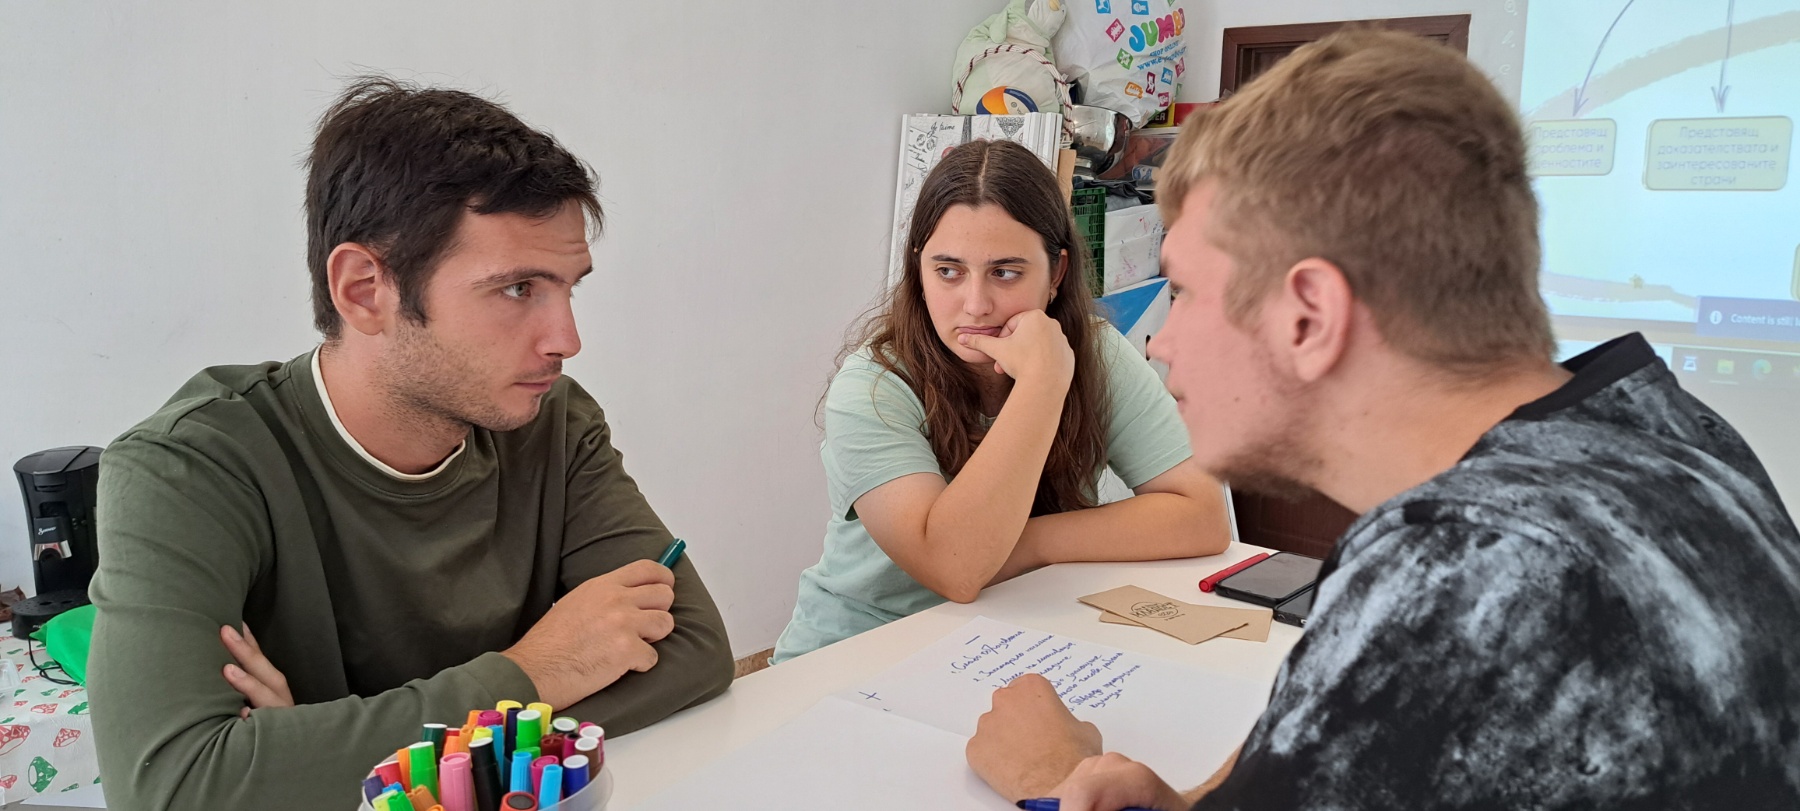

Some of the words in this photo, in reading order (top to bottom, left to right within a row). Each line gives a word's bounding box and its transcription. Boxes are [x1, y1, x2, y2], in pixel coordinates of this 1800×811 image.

[1680, 126, 1759, 138] Представящ
[1770, 144, 1779, 152] и
[1690, 176, 1736, 185] страни
[1730, 313, 1765, 324] Content
[1767, 315, 1775, 325] is
[1777, 316, 1793, 326] still
